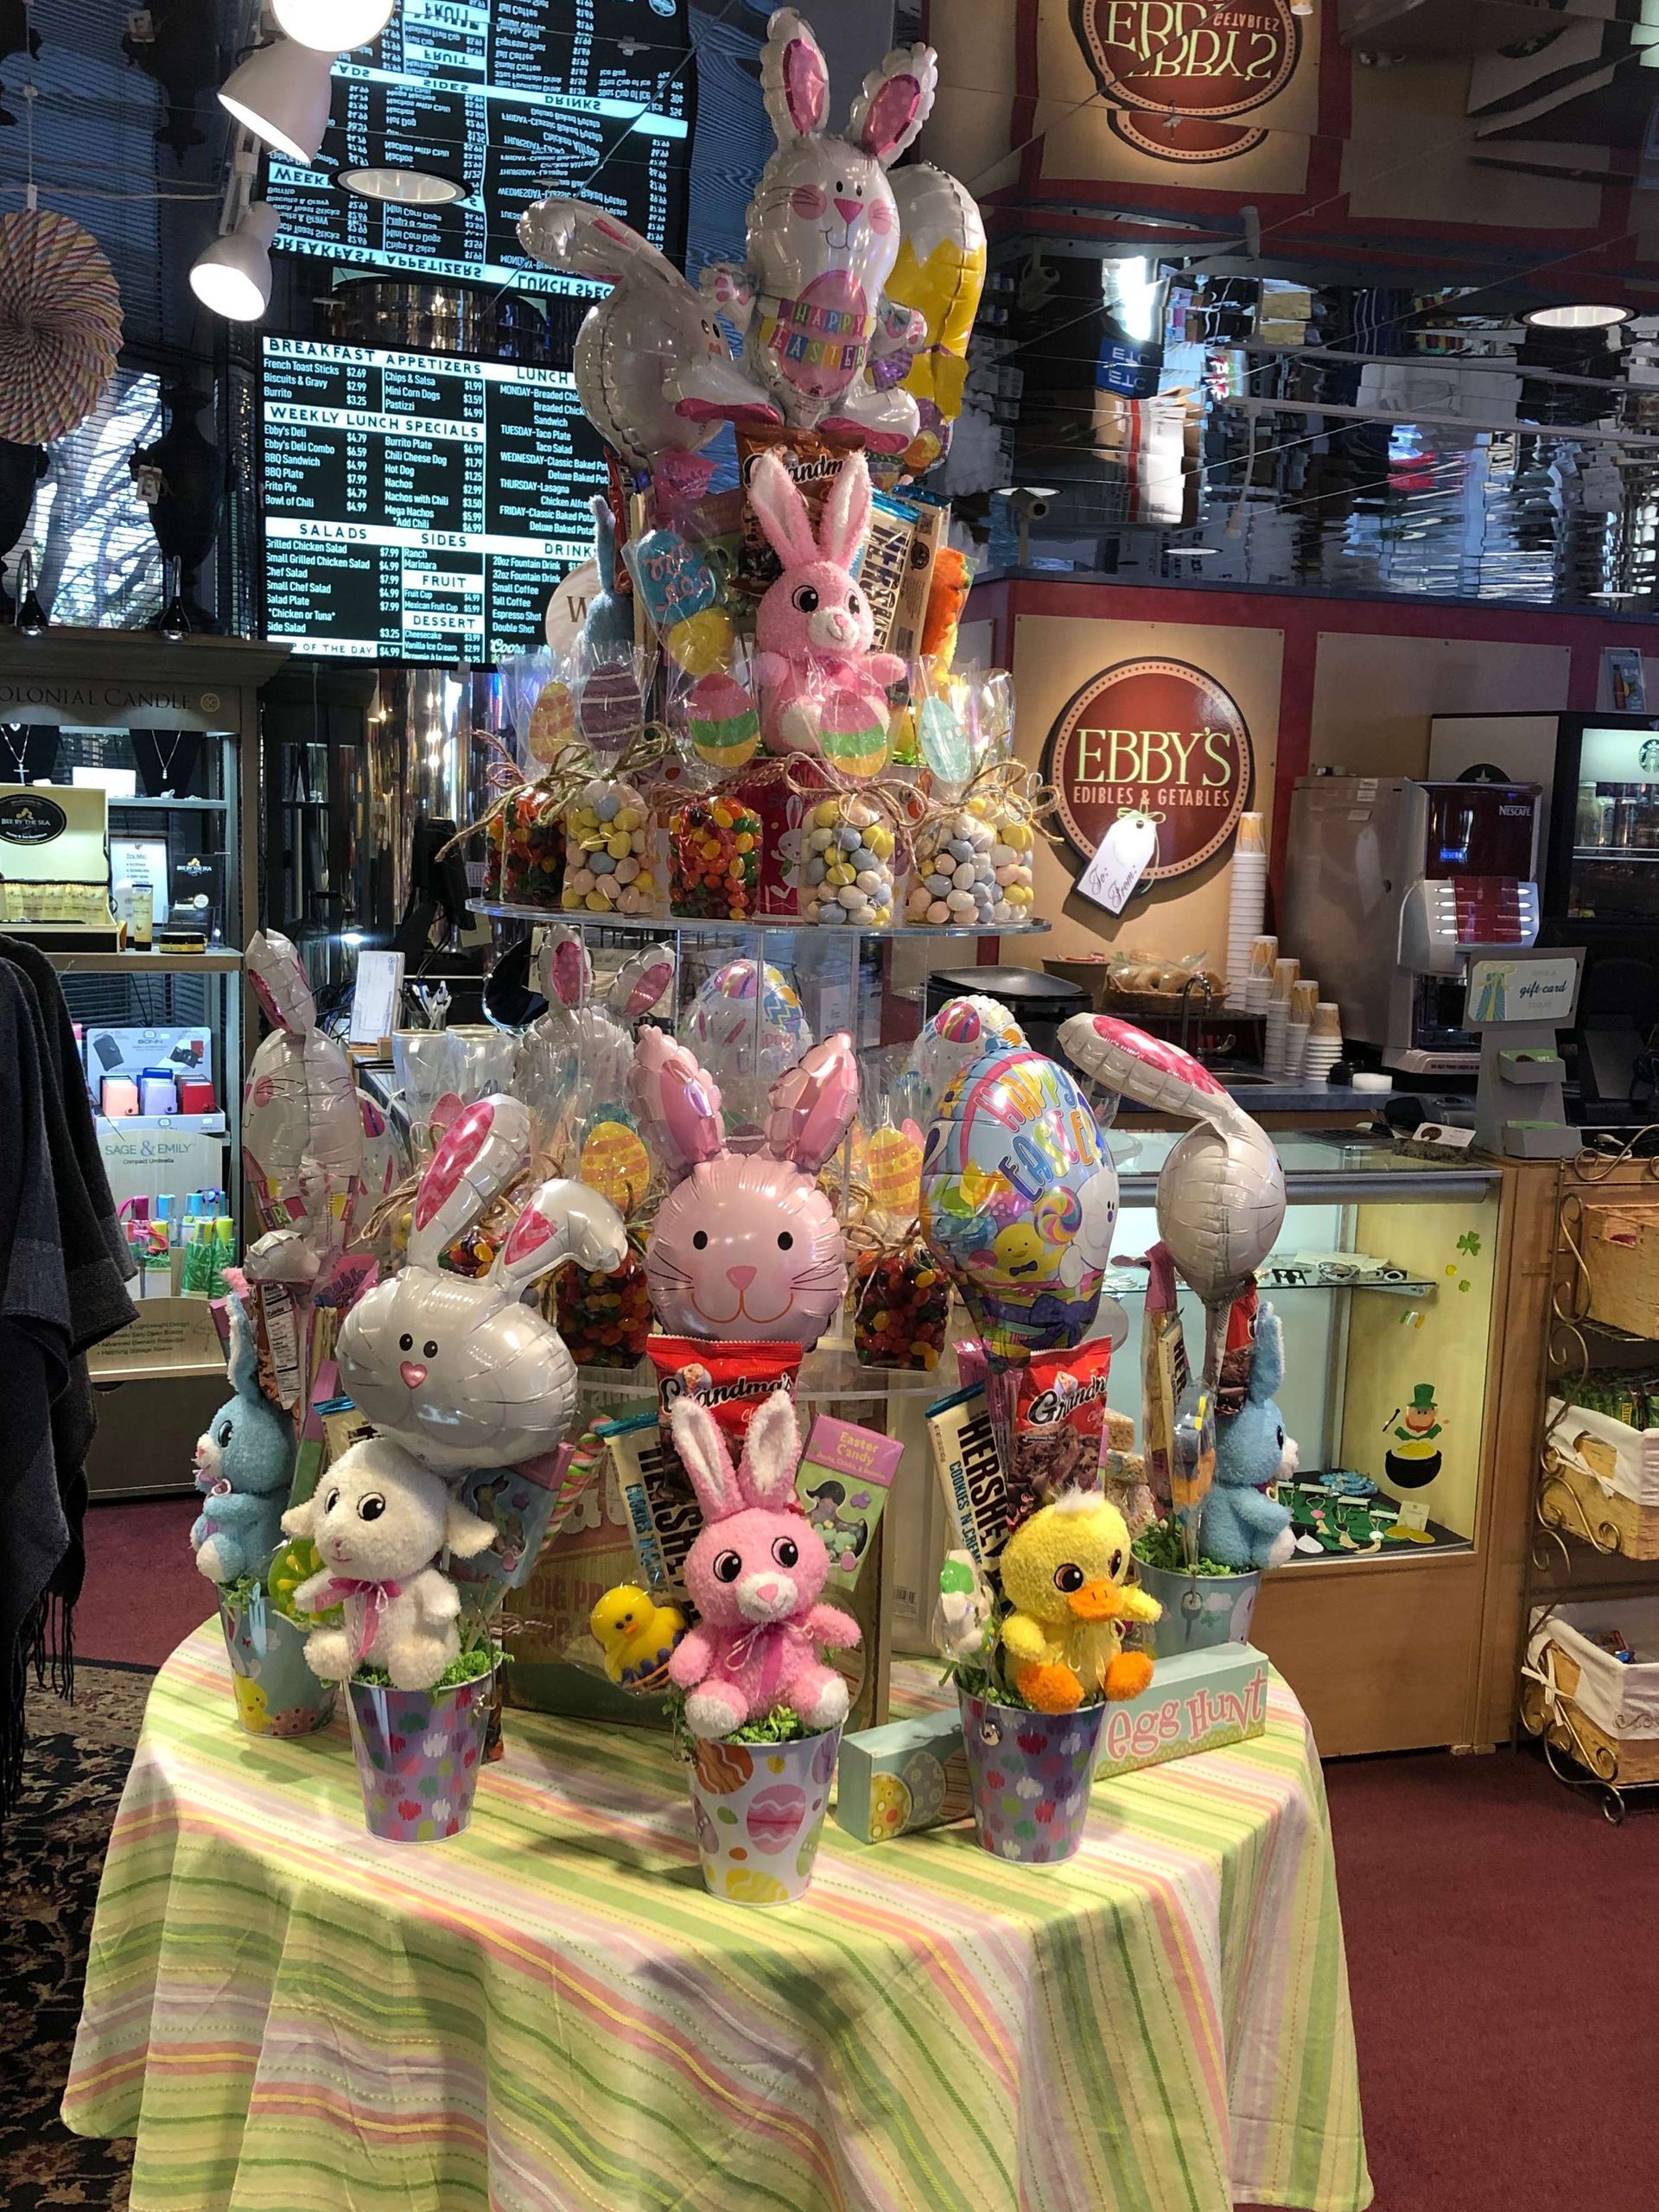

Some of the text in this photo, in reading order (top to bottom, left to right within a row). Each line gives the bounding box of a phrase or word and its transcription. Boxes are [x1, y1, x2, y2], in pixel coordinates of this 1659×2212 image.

[795, 304, 864, 333] HAPPY
[269, 339, 375, 362] BREAKFAST
[773, 327, 864, 366] EASTER
[264, 359, 366, 378] French Toast Sticks $2.69
[386, 354, 481, 374] APPETIZERS
[264, 372, 366, 392] Biscuits & Gravy $2.99
[385, 372, 482, 391] Chips & Salsa $1.99
[518, 367, 568, 384] LUNCH
[264, 386, 366, 406] Burrito $3.25
[385, 385, 482, 405] Mini Corn Dogs $3.59
[385, 399, 483, 418] Pastizzi $4.99
[534, 401, 563, 413] Breaded
[270, 406, 478, 437] WEEKLY LUNCH SPECIALS
[534, 416, 568, 427] Sandwich
[264, 424, 307, 437] Ebby's Deli
[553, 429, 571, 441] Plate
[264, 438, 335, 454] Ebby's Deli Combo
[385, 436, 433, 450] Burrito Plate
[536, 442, 573, 454] Taco Salad
[264, 453, 321, 467] BBQ Sandwich
[385, 450, 448, 467] Chili Cheese Dog
[264, 467, 304, 479] BBQ Plate
[385, 464, 415, 477] Hot Dog
[264, 481, 298, 493] Frito Pie
[385, 478, 413, 489] Nachos
[265, 495, 315, 508] Bowl of Chili
[385, 492, 448, 505] Nachos with Chili
[541, 495, 569, 507] Chicken
[385, 505, 435, 518] Mega Nachos
[412, 519, 429, 529] Chili
[300, 524, 367, 539] SALADS
[266, 538, 347, 554] Grilled Chicken Salad
[422, 533, 467, 547] SIDES
[266, 552, 370, 569] Small Grilled Chicken Salad
[404, 548, 428, 559] Ranch
[404, 561, 437, 570] Marinara
[493, 556, 509, 566] 20oz
[511, 558, 541, 569] Fountain
[542, 561, 561, 570] Drink
[267, 566, 308, 578] Chef Salad
[493, 569, 561, 583] 32oz Fountain Drink
[267, 580, 332, 594] Small Chef Salad
[423, 575, 466, 588] FRUIT
[493, 583, 539, 595] Small Coffee
[267, 594, 310, 606] Salad Plate
[493, 596, 531, 607] Tall Coffee
[414, 615, 475, 629] DESSERT
[493, 609, 542, 621] Espresso Shot
[267, 621, 306, 633] Side Salad
[493, 622, 535, 633] Double Shot
[303, 643, 372, 654] OF THE DAY
[0, 686, 192, 709] OLONIAL CANDLE
[1075, 727, 1231, 786] EBBY'S
[1072, 786, 1230, 807] EDIBLES & GETABLES
[1088, 865, 1109, 895] To:
[1107, 864, 1138, 909] From:
[1520, 981, 1567, 999] gift card
[974, 1062, 1077, 1133] HAPPY
[105, 1141, 191, 1156] SAGE & EMILY
[660, 1372, 793, 1414] Gandma's
[840, 1432, 879, 1452] Easter
[836, 1444, 874, 1466] Candy
[950, 1461, 970, 1510] COOKIES
[1106, 1700, 1181, 1761] egg
